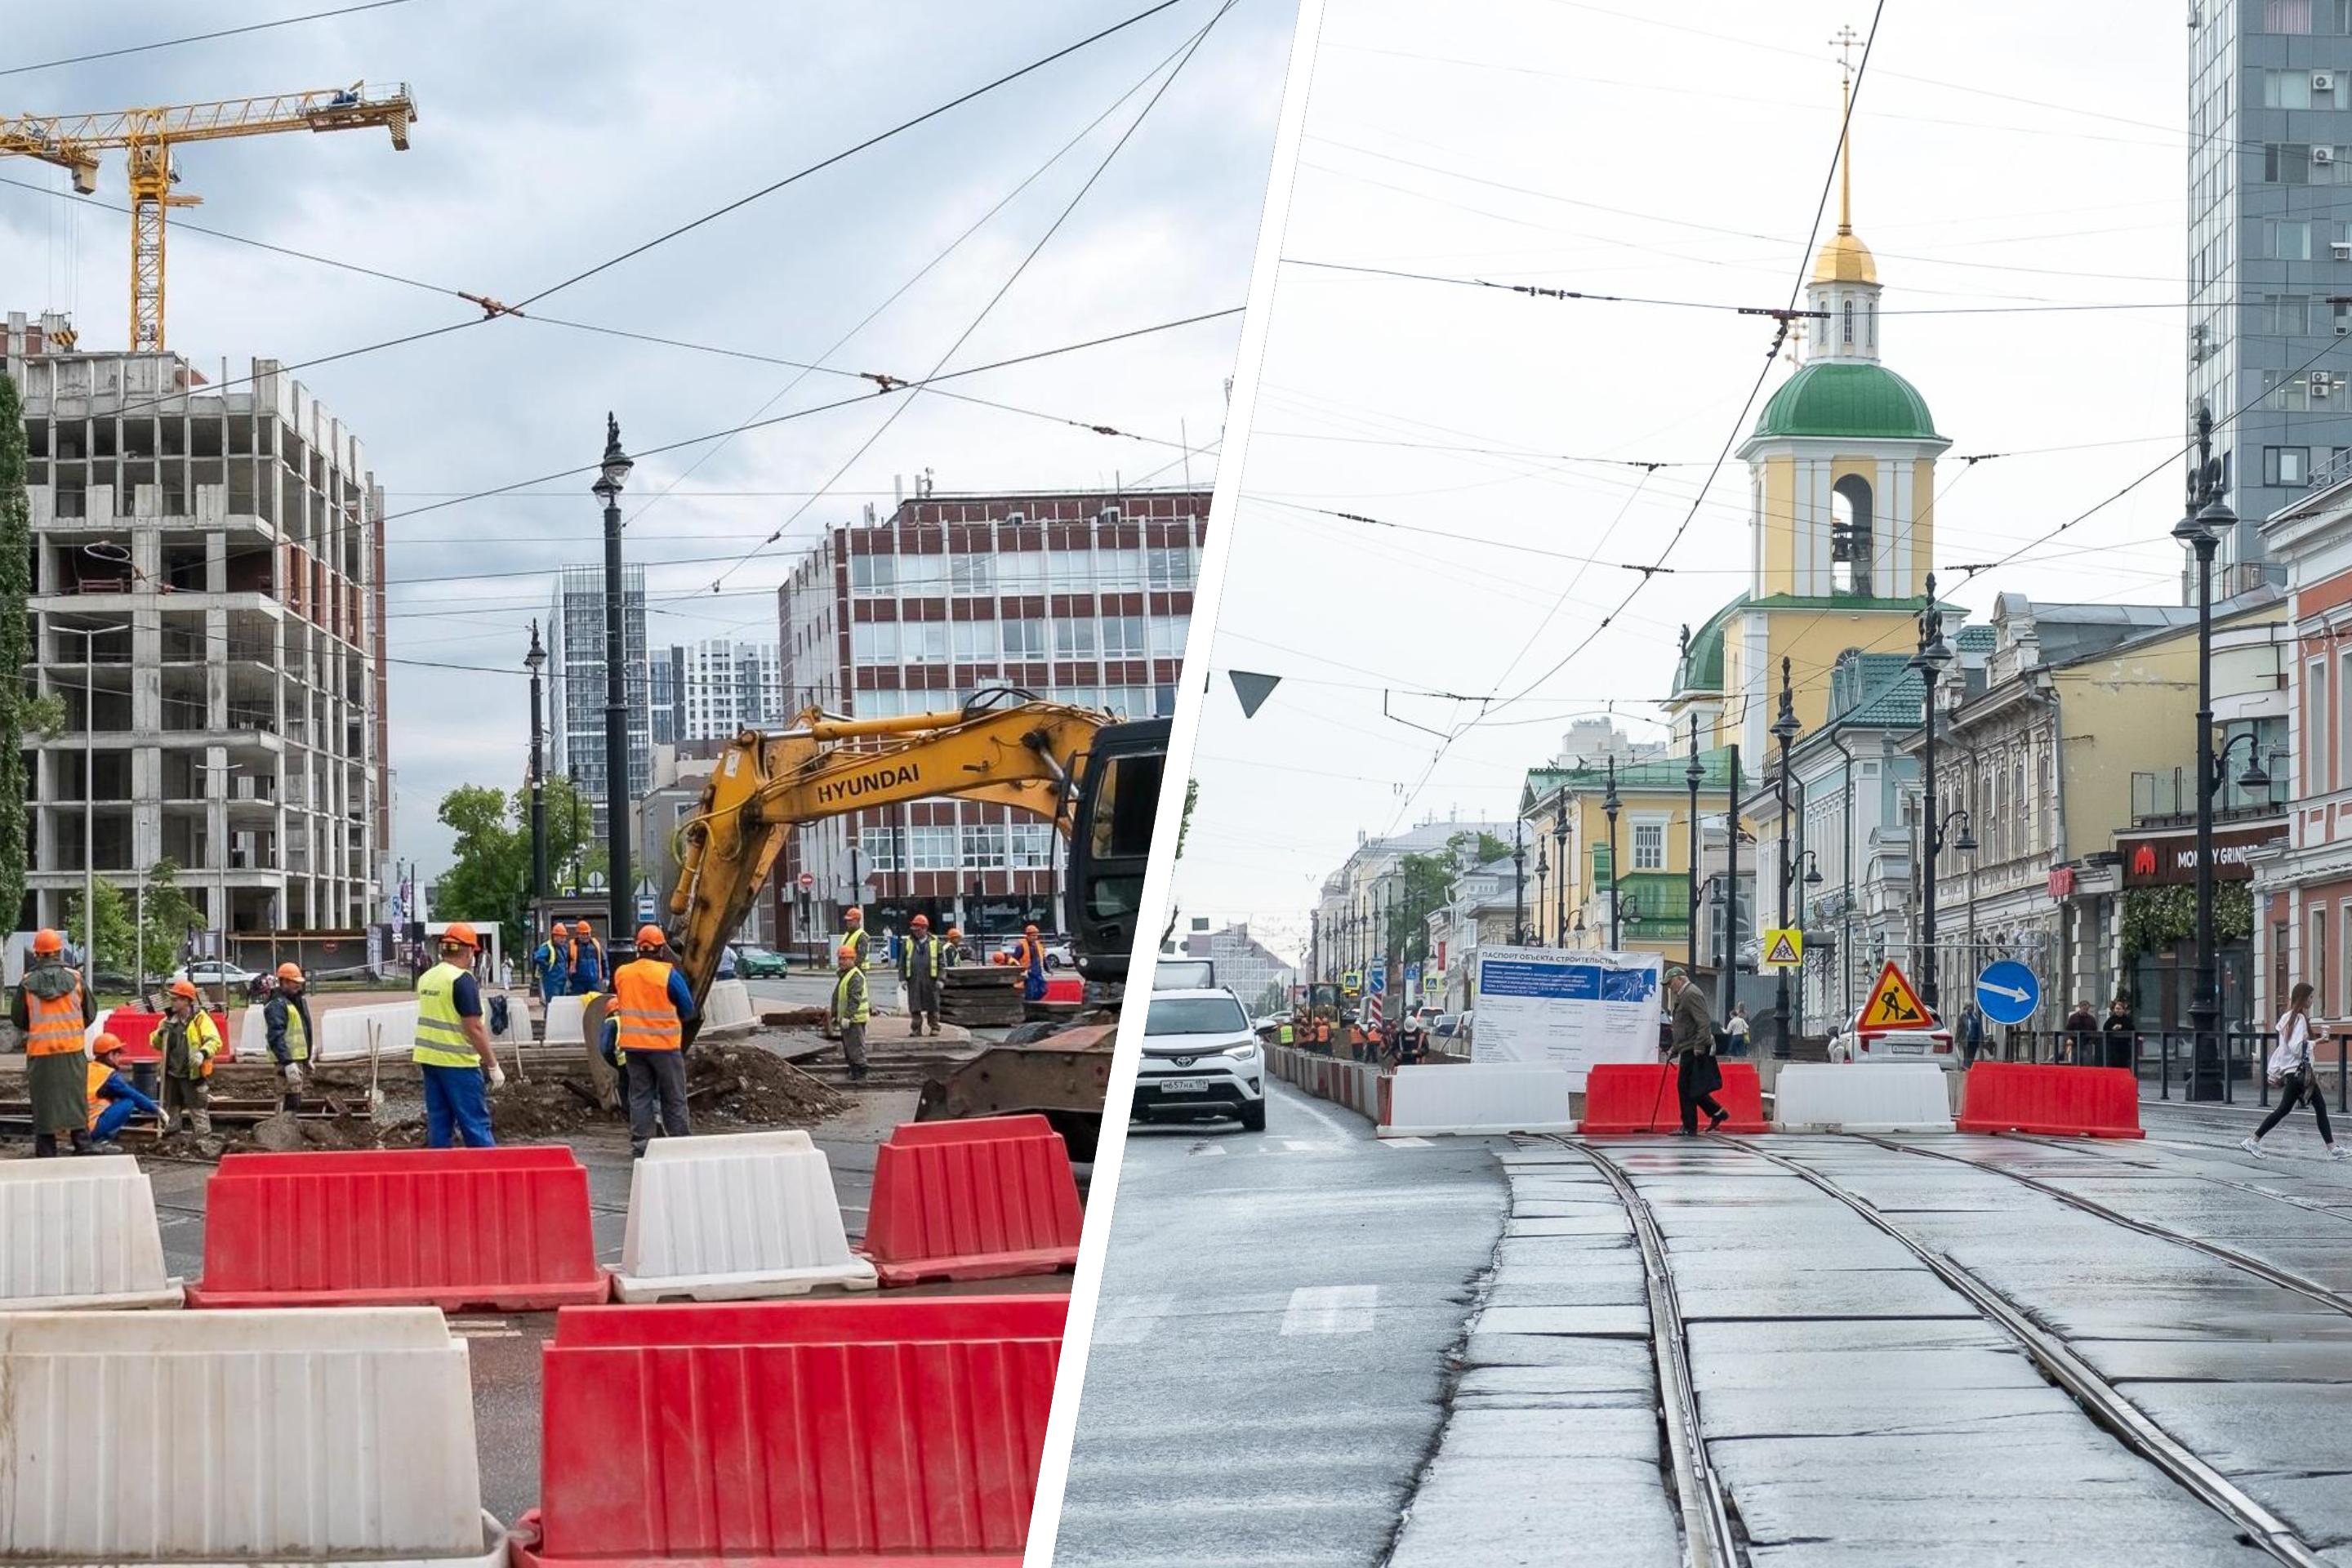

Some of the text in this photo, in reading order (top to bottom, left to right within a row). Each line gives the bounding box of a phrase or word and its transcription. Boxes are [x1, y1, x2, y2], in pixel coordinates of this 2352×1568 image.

[817, 764, 920, 804] HYUNDAI
[2177, 848, 2219, 868] MONY
[1482, 951, 1619, 965] ПАСПОРТ ОБЪЕКТА СТРОИТЕЛЬСТВА
